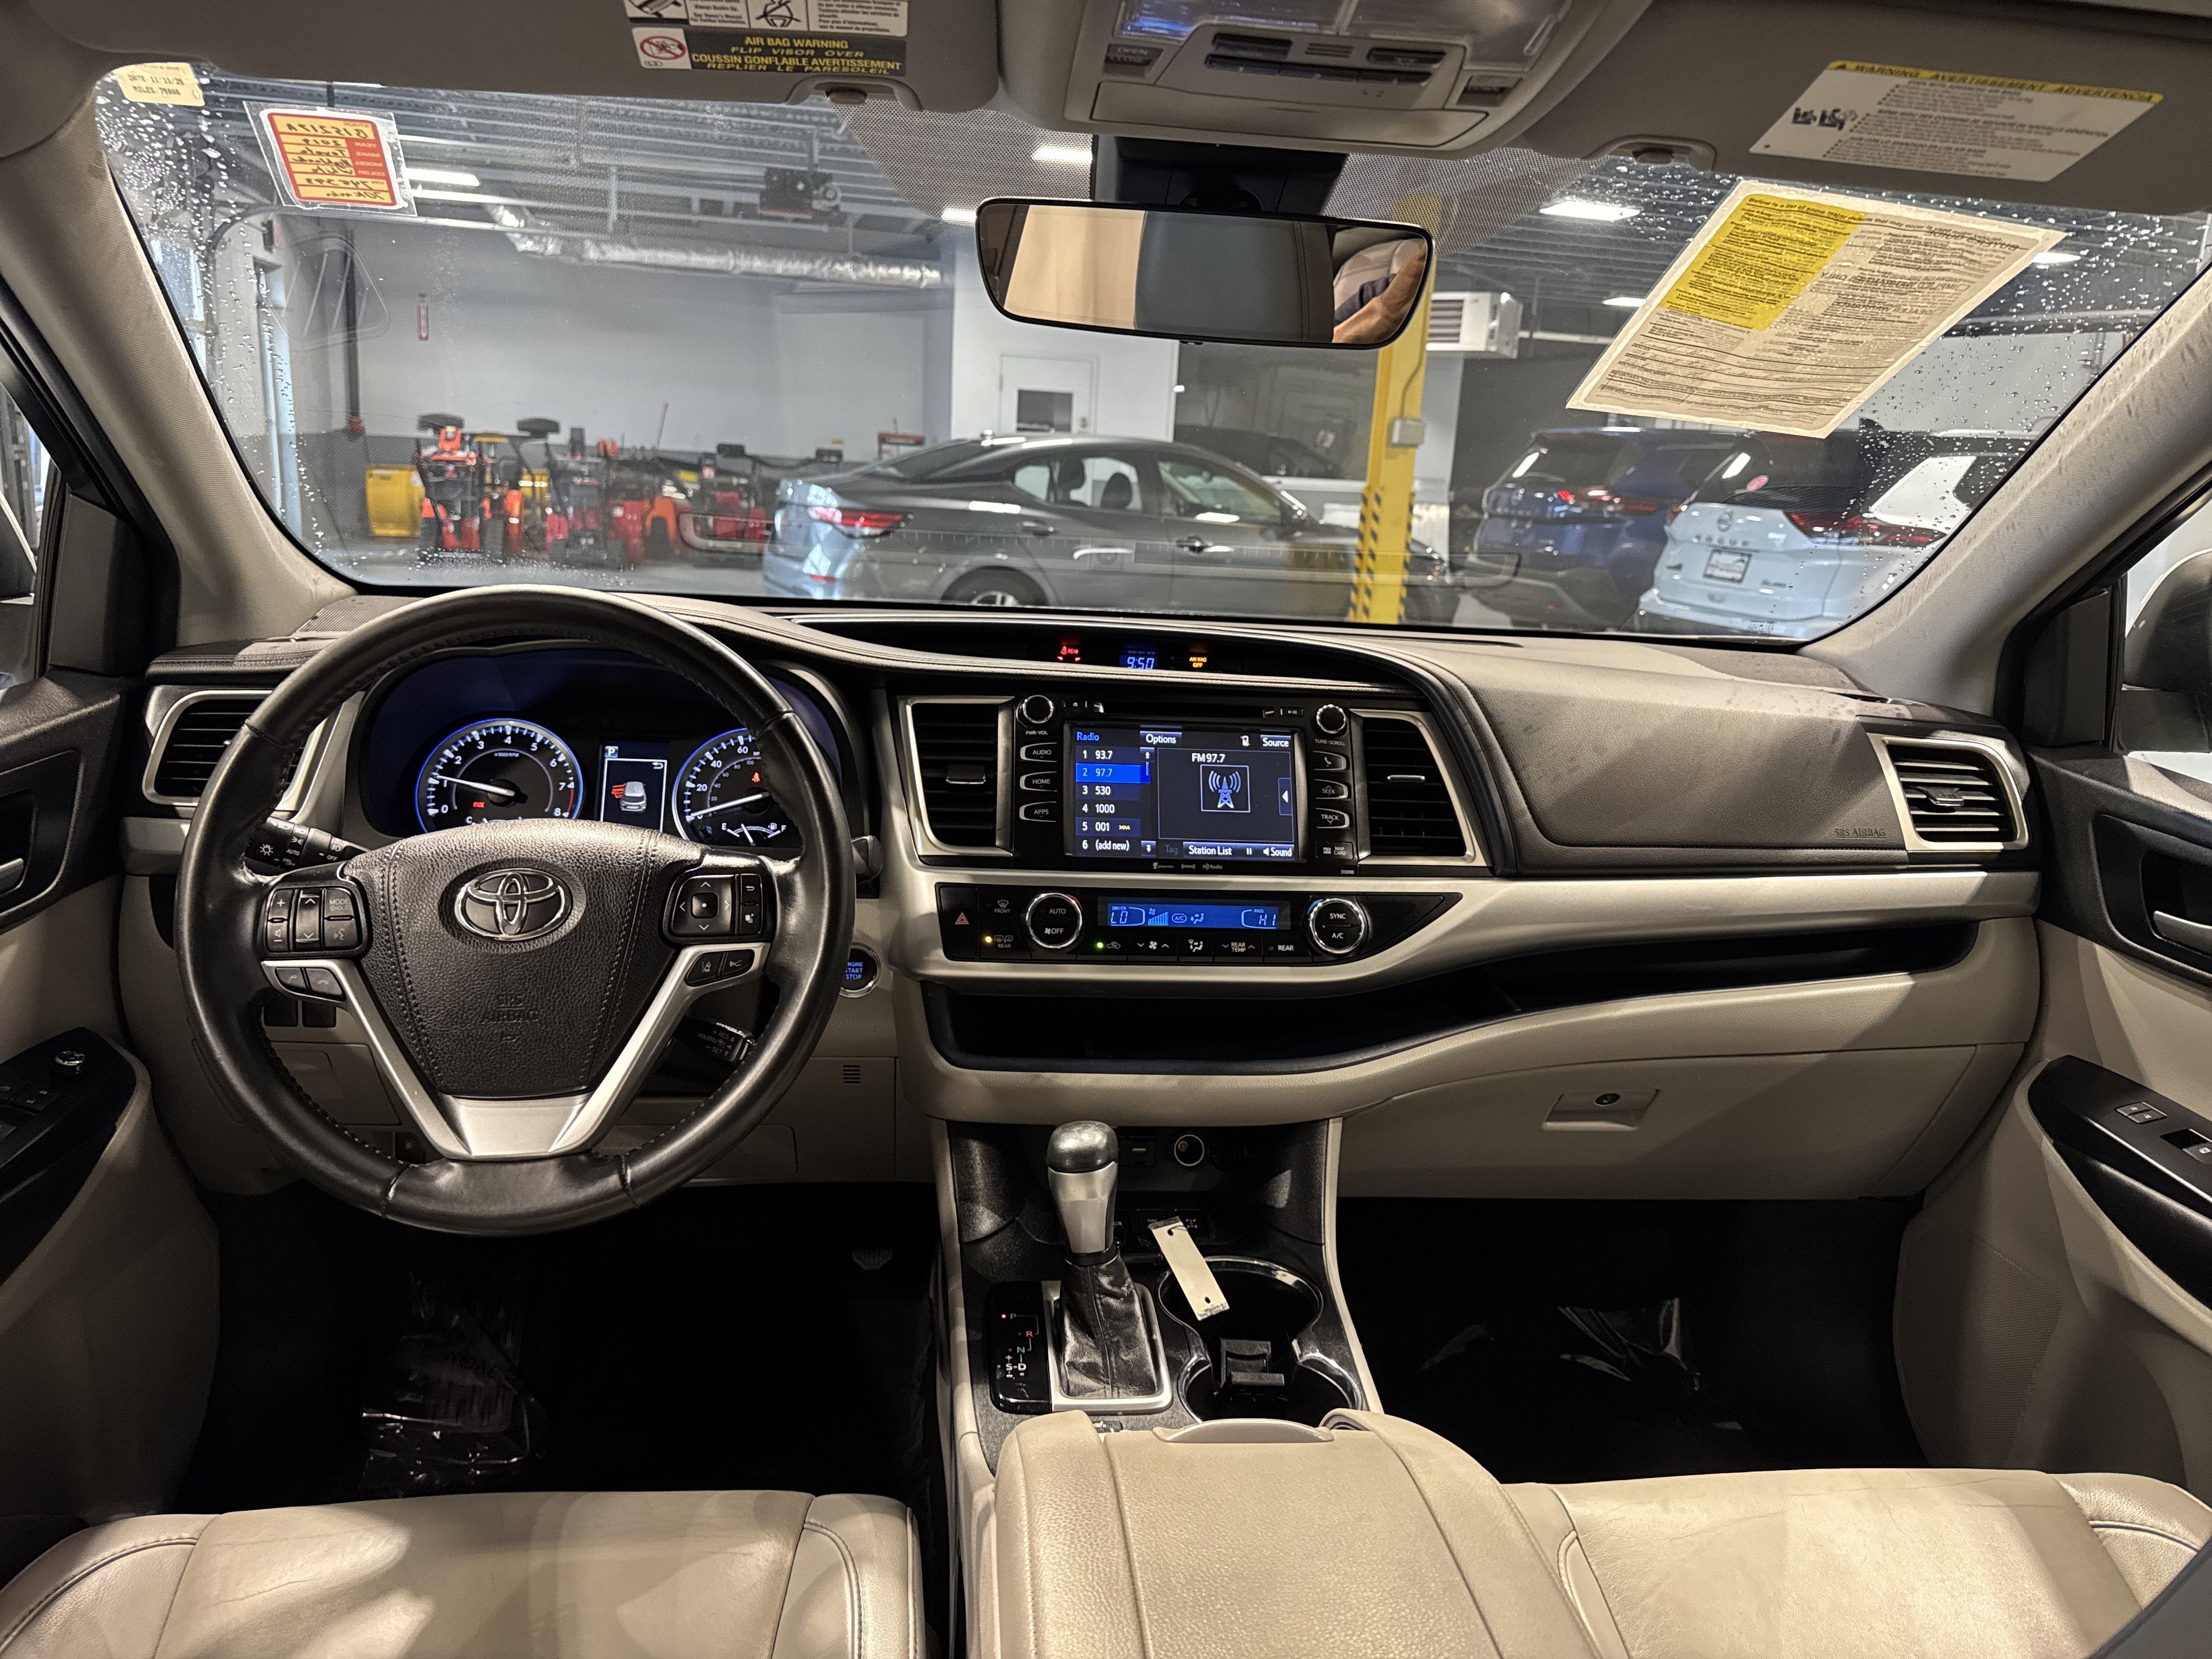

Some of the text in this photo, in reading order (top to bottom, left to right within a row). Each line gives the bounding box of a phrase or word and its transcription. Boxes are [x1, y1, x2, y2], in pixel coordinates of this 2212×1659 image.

[745, 37, 848, 49] AIR BAG WARNING
[692, 53, 901, 70] COUSSIN GONFLABLE AVERTISSEMENT
[805, 66, 890, 75] PARESOLEIL
[1748, 198, 1771, 206] Below
[1806, 207, 1826, 215] some
[1827, 211, 1847, 219] major
[1888, 220, 1904, 228] may
[1127, 656, 1155, 670] 9:50
[504, 736, 512, 744] 4
[1076, 731, 1099, 741] Radio
[1146, 733, 1176, 744] Options
[477, 741, 485, 750] 3
[530, 742, 538, 752] 5
[1262, 738, 1289, 747] Source
[607, 747, 616, 757] P
[1082, 750, 1113, 760] 1 93.7
[454, 756, 462, 765] 2
[549, 758, 557, 768] 6
[710, 760, 722, 768] 40
[1082, 768, 1113, 777] 2 97.7
[442, 780, 448, 788] 1
[558, 782, 565, 791] 7
[697, 783, 708, 792] 20
[1082, 786, 1111, 795] 3 530
[440, 805, 449, 814] 0
[554, 808, 562, 817] 8
[1082, 804, 1115, 813] 4 1000
[1082, 822, 1088, 831] 5
[1095, 822, 1110, 831] 001
[1835, 828, 1886, 837] SRS AIRBAG
[1082, 839, 1130, 851] 6 (add new)
[1165, 844, 1178, 855] Tag
[1188, 845, 1232, 855] Station List
[1271, 848, 1292, 857] Sound
